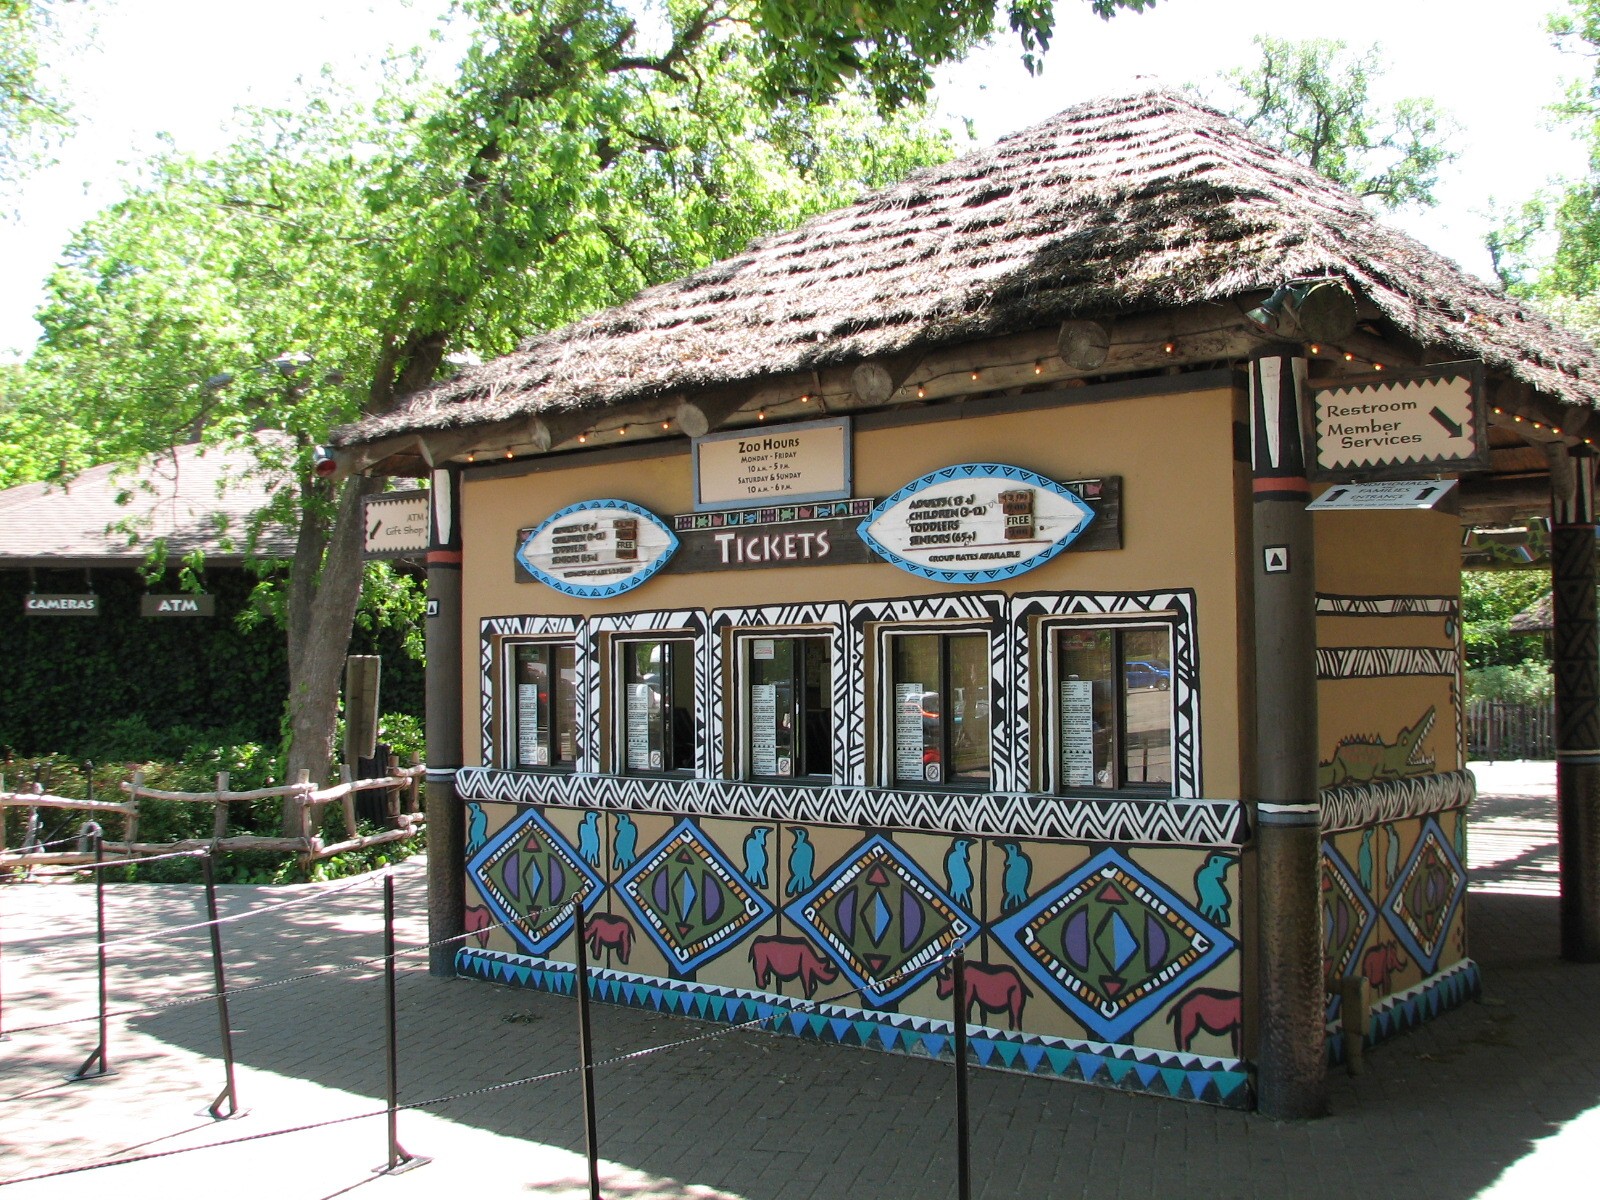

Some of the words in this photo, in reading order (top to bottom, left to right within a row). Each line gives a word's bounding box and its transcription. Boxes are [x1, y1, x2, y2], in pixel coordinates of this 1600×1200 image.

[1327, 401, 1417, 418] Restroom
[1327, 419, 1402, 437] Member
[763, 438, 800, 451] HOURS
[1341, 432, 1422, 449] Services
[741, 454, 769, 464] MONDAY
[774, 451, 797, 460] FRIDAY
[747, 465, 756, 473] 10
[738, 475, 769, 485] SATURDAY
[770, 473, 775, 481] &
[776, 471, 802, 480] SUNDAY
[775, 483, 779, 491] 6
[407, 513, 425, 522] ATM
[909, 508, 959, 520] CHILDREN
[1006, 515, 1030, 526] FREE
[403, 524, 424, 537] Shop
[617, 541, 633, 549] FREE
[909, 533, 951, 546] SENIORS
[714, 529, 832, 564] TICKETS
[928, 554, 955, 562] GROUP
[955, 552, 978, 561] RATES
[979, 550, 1021, 560] AVAILABLE
[27, 599, 95, 610] CAMERAS
[158, 599, 198, 612] ATM
